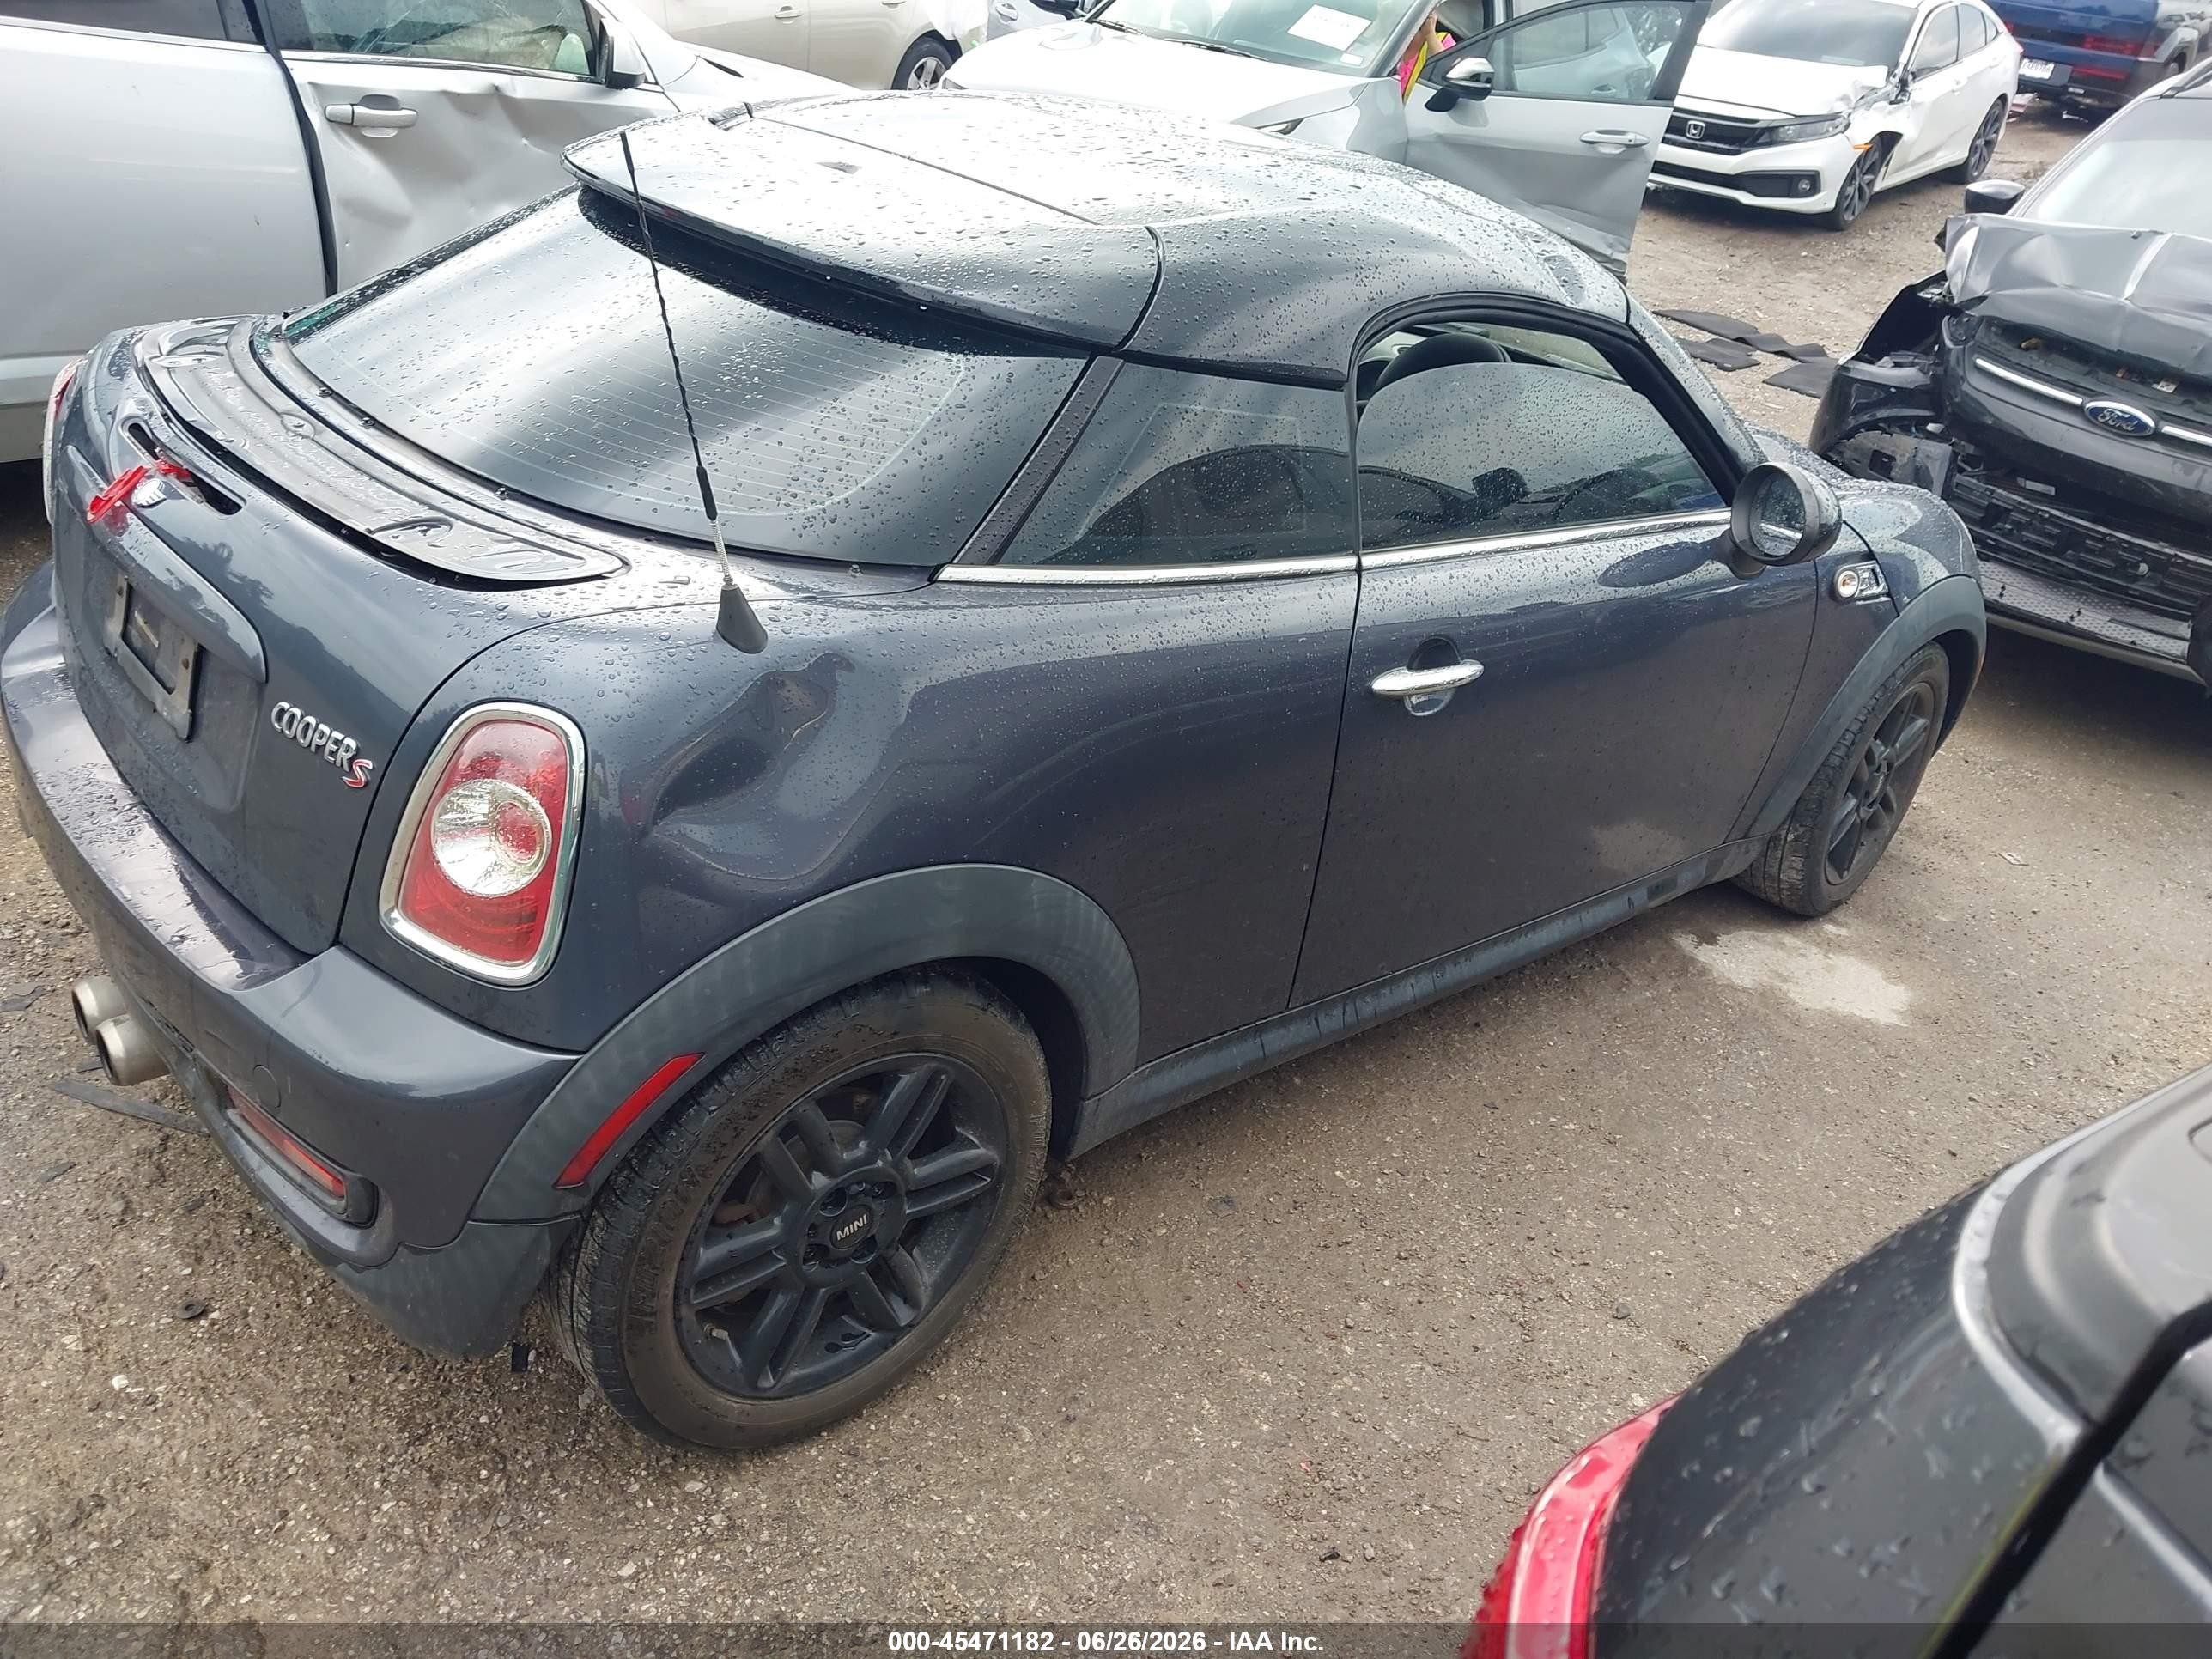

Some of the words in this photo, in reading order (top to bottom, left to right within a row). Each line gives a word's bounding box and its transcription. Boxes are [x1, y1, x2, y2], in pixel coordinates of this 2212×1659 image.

[2097, 408, 2139, 431] Ford
[270, 701, 357, 772] COOPER
[342, 758, 374, 788] S
[836, 1213, 867, 1241] MINI
